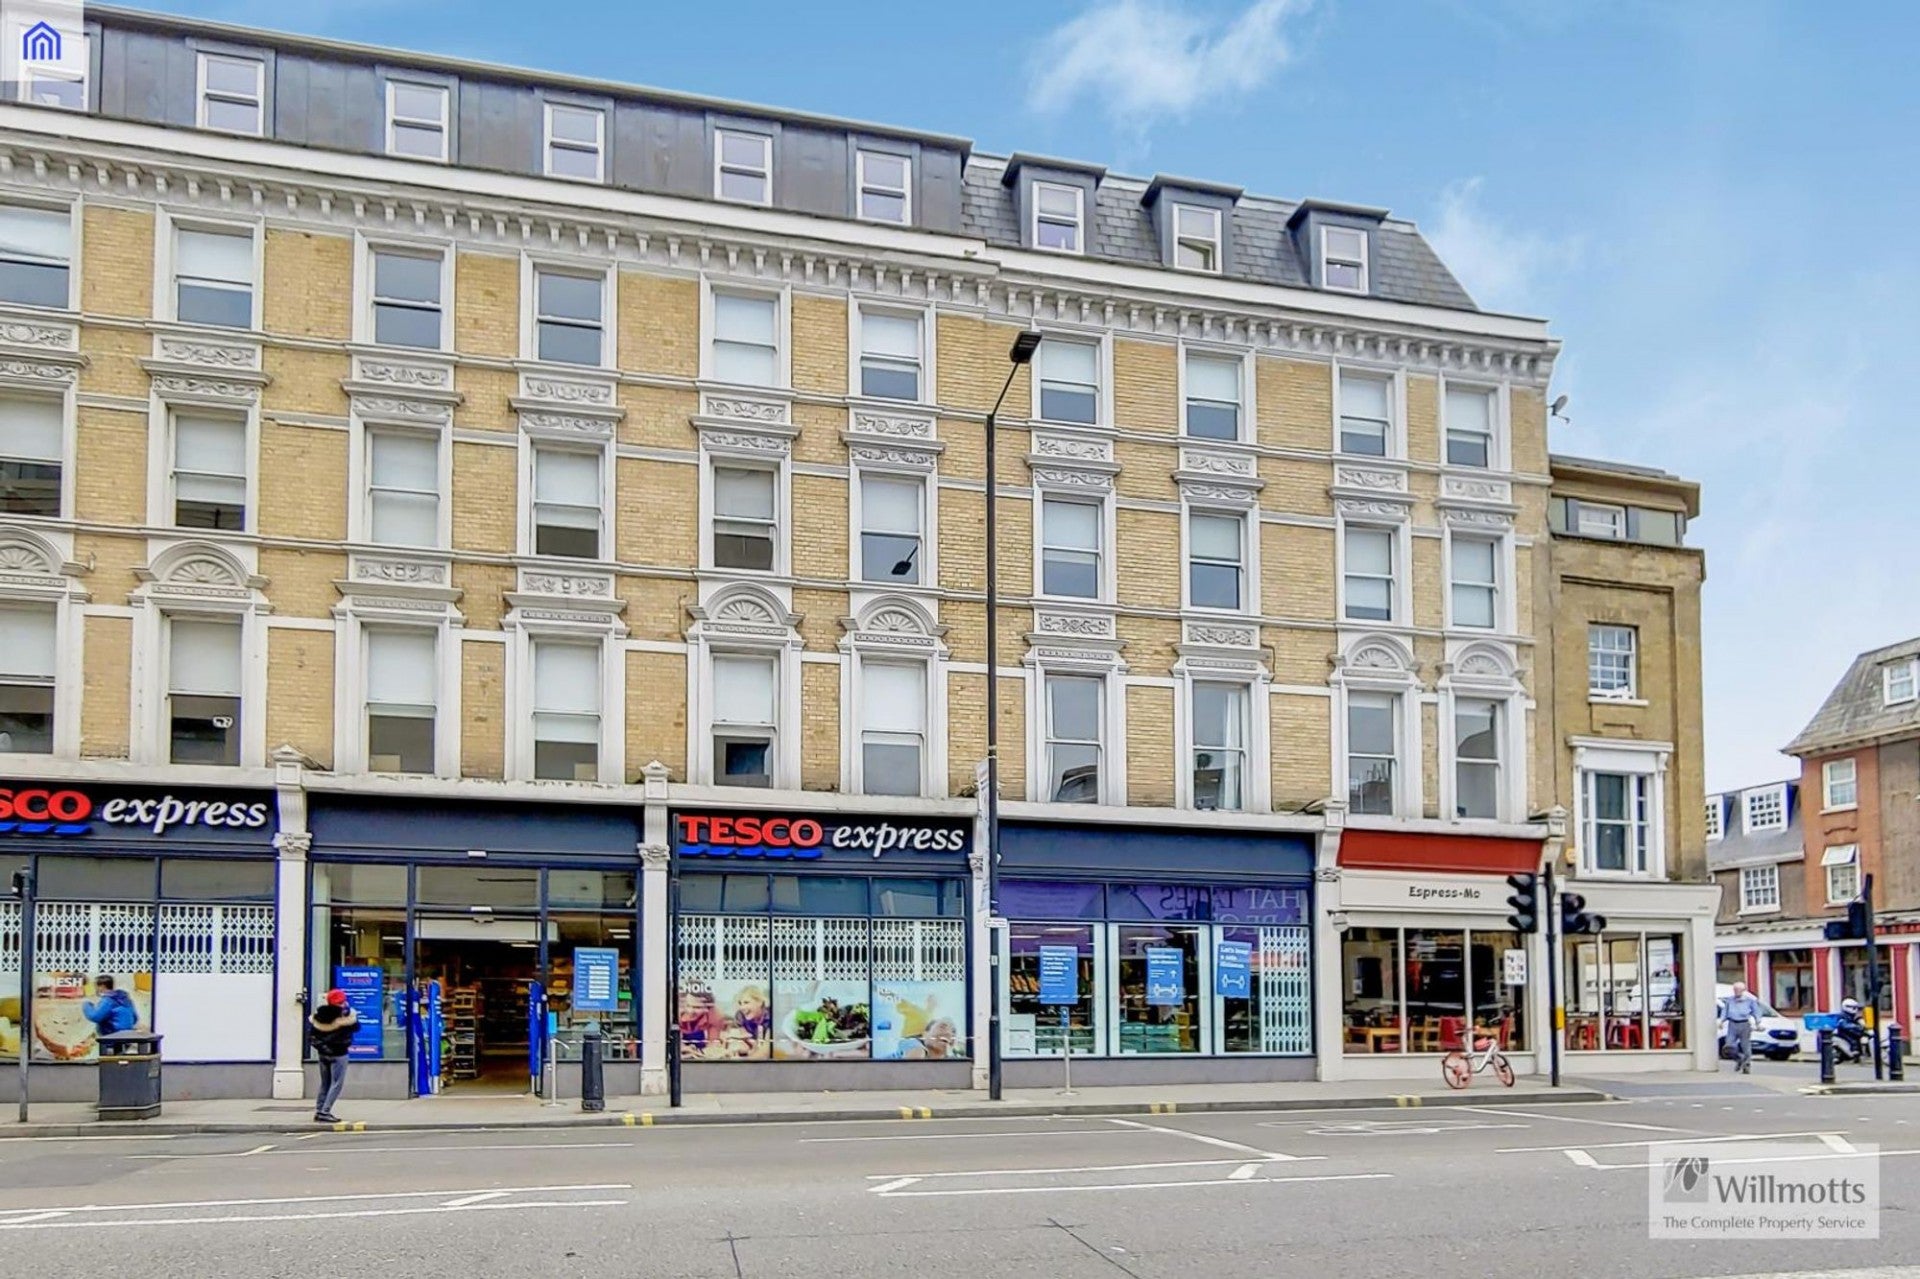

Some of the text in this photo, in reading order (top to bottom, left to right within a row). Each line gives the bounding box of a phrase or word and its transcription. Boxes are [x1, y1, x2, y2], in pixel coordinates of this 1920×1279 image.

[102, 794, 267, 834] express
[678, 816, 964, 858] TESCO express
